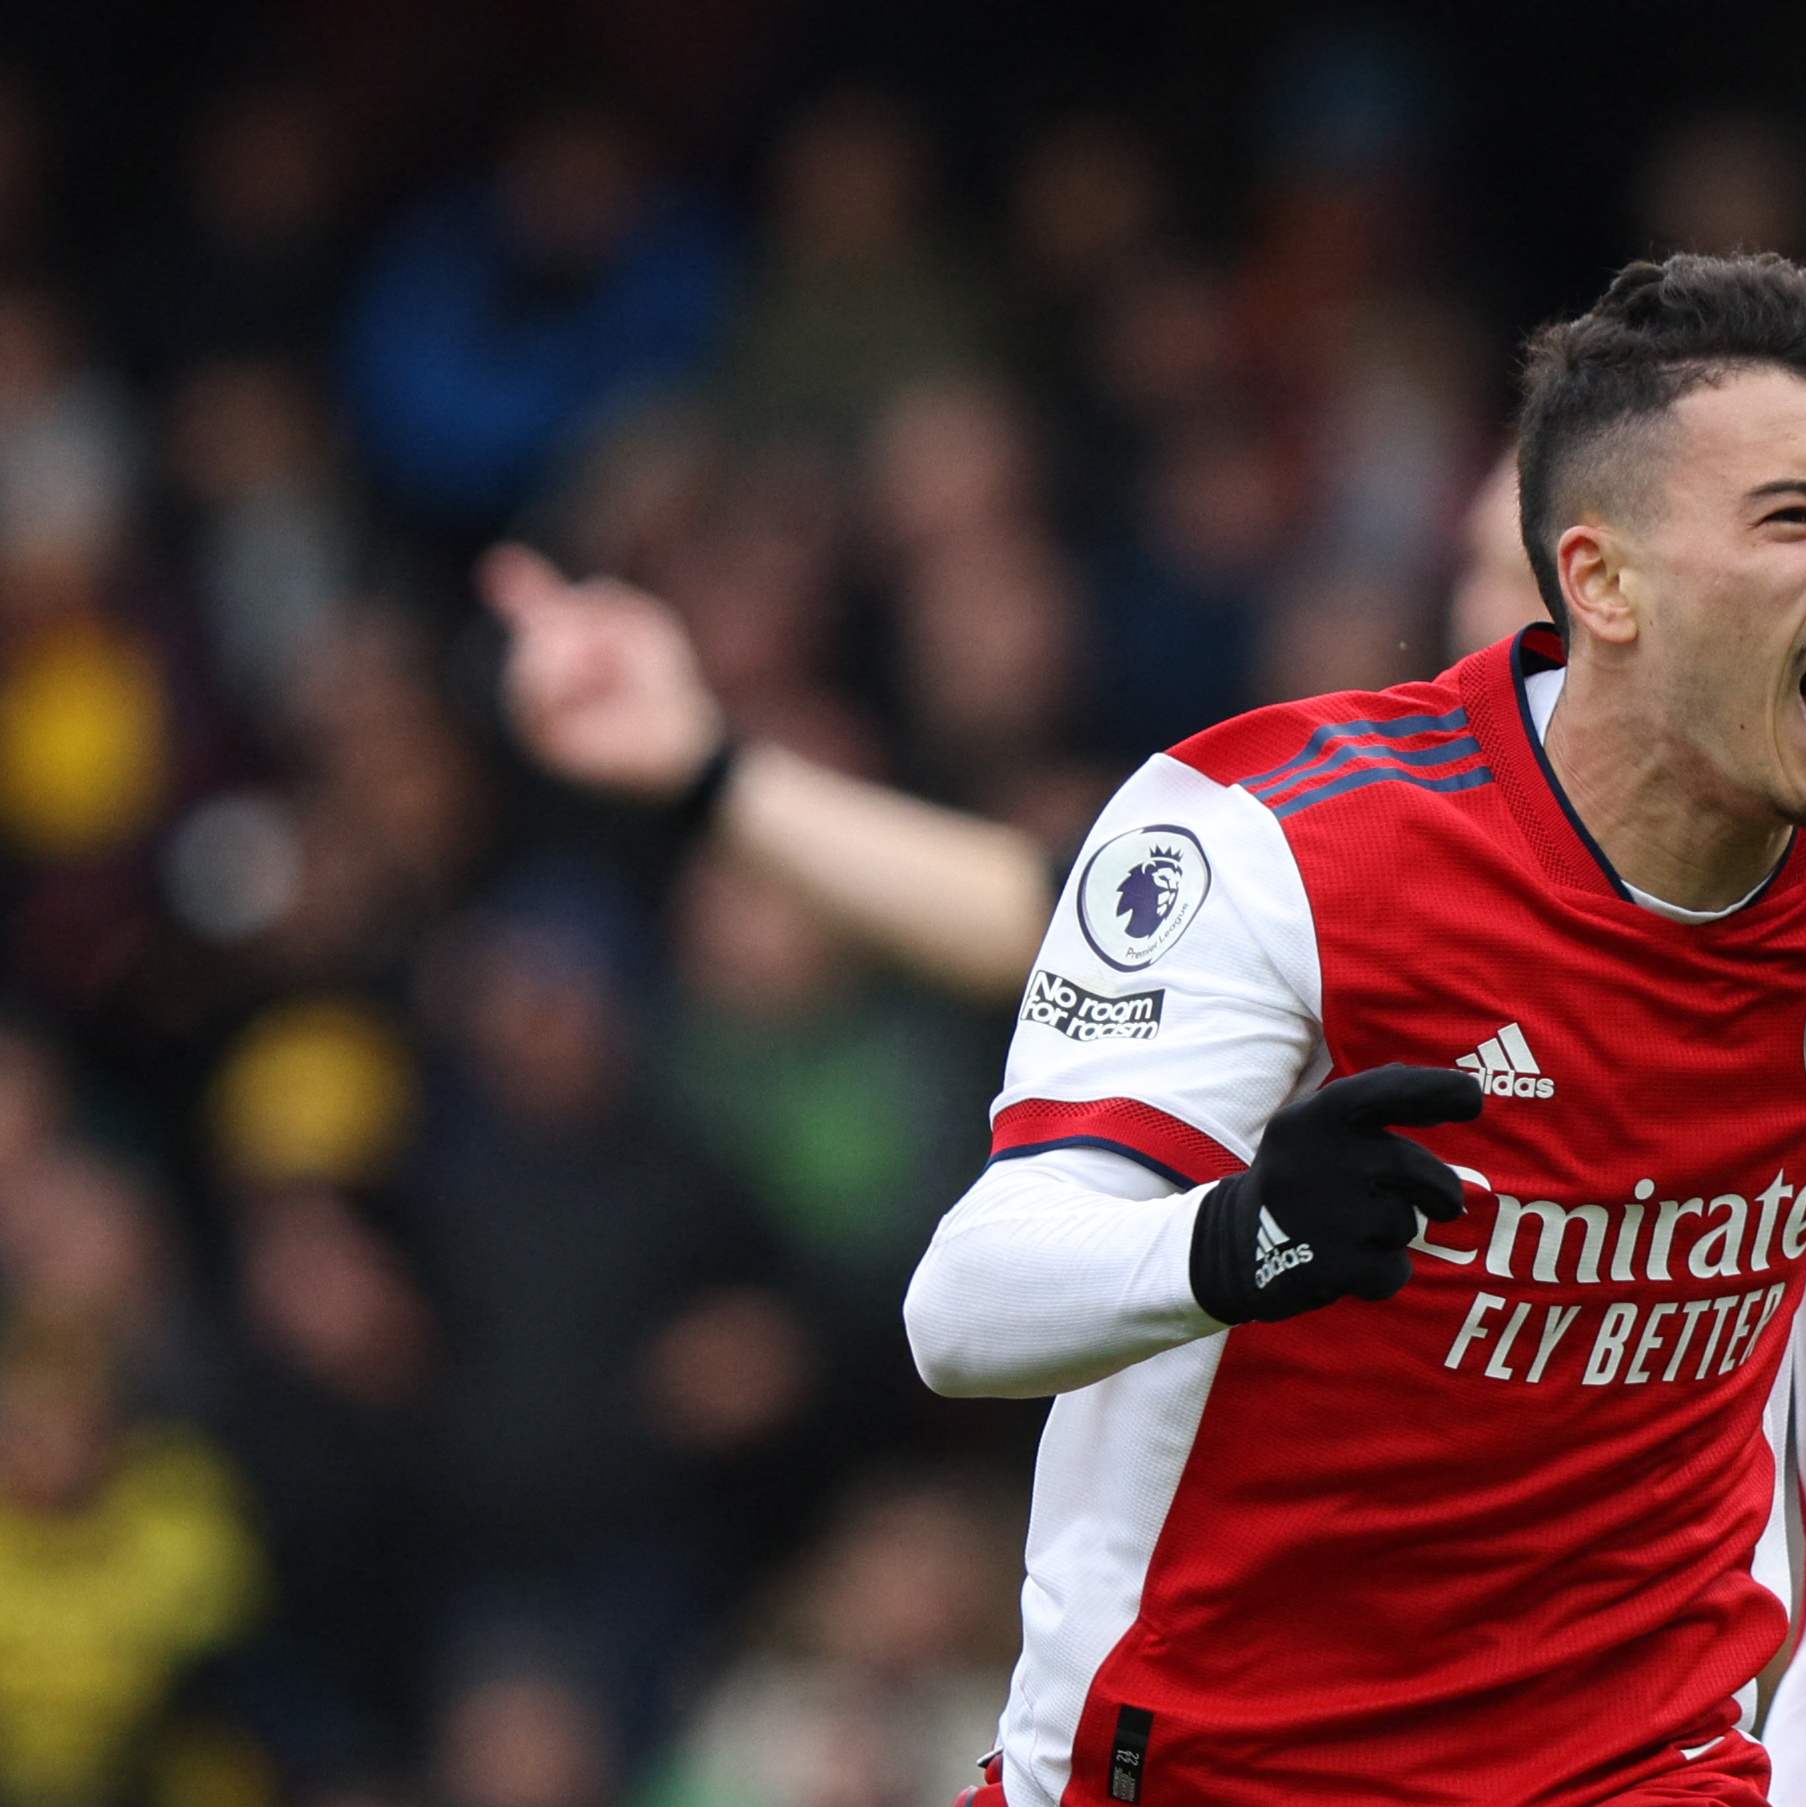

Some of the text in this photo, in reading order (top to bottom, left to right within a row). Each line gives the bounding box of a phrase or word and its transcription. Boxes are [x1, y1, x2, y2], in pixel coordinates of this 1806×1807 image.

[1021, 994, 1158, 1042] for racism
[1029, 970, 1154, 1024] No room
[1444, 1291, 1582, 1384] FLY
